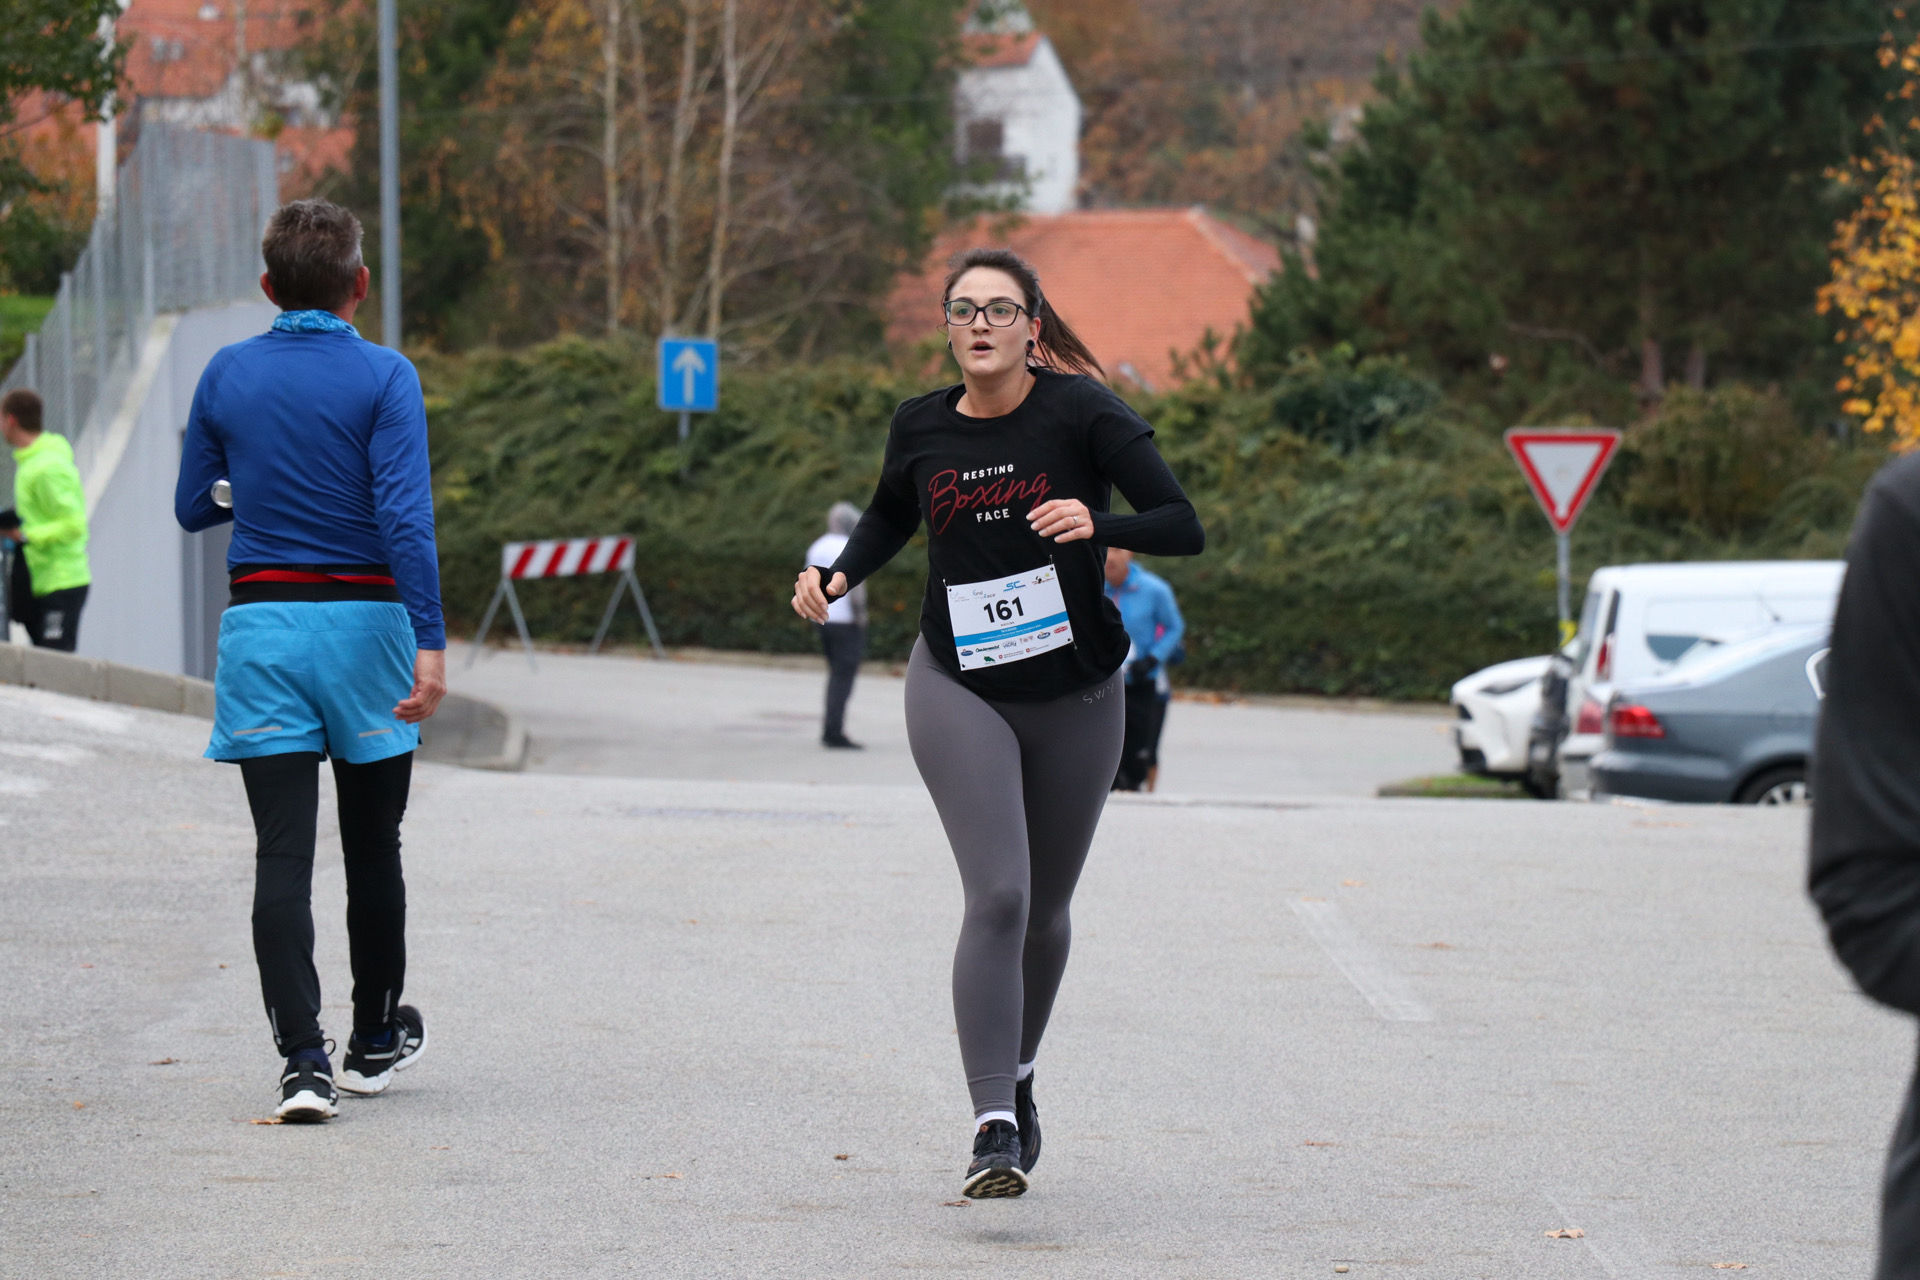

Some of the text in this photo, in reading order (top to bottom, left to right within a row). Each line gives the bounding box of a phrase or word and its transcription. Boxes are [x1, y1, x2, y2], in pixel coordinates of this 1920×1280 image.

[963, 464, 1014, 481] RESTING
[928, 469, 1051, 535] Boxing
[976, 508, 1010, 523] FACE
[983, 596, 1024, 623] 161
